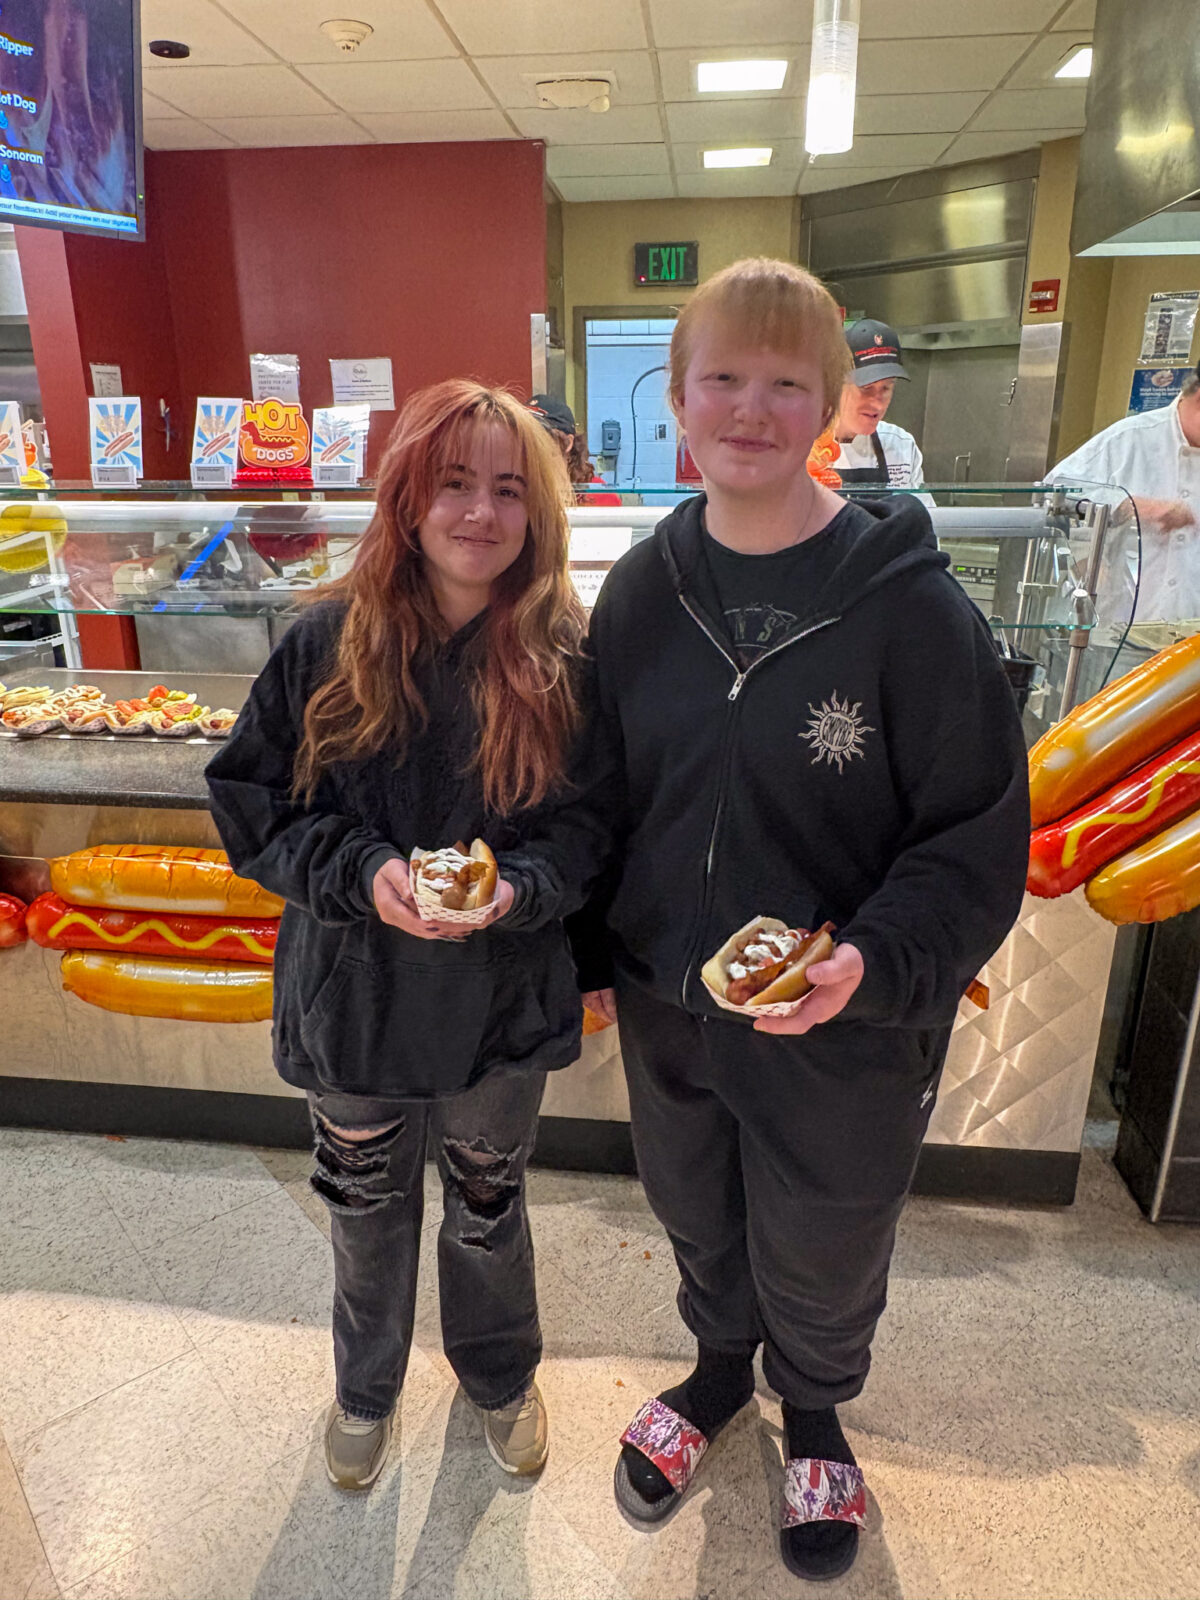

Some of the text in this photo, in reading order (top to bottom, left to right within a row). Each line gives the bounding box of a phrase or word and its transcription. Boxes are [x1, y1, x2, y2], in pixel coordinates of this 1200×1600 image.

[0, 92, 37, 114] ot Dog
[0, 144, 43, 166] Sonoran
[648, 247, 687, 280] EXIT
[243, 400, 300, 431] HOT
[256, 448, 295, 462] DOGS
